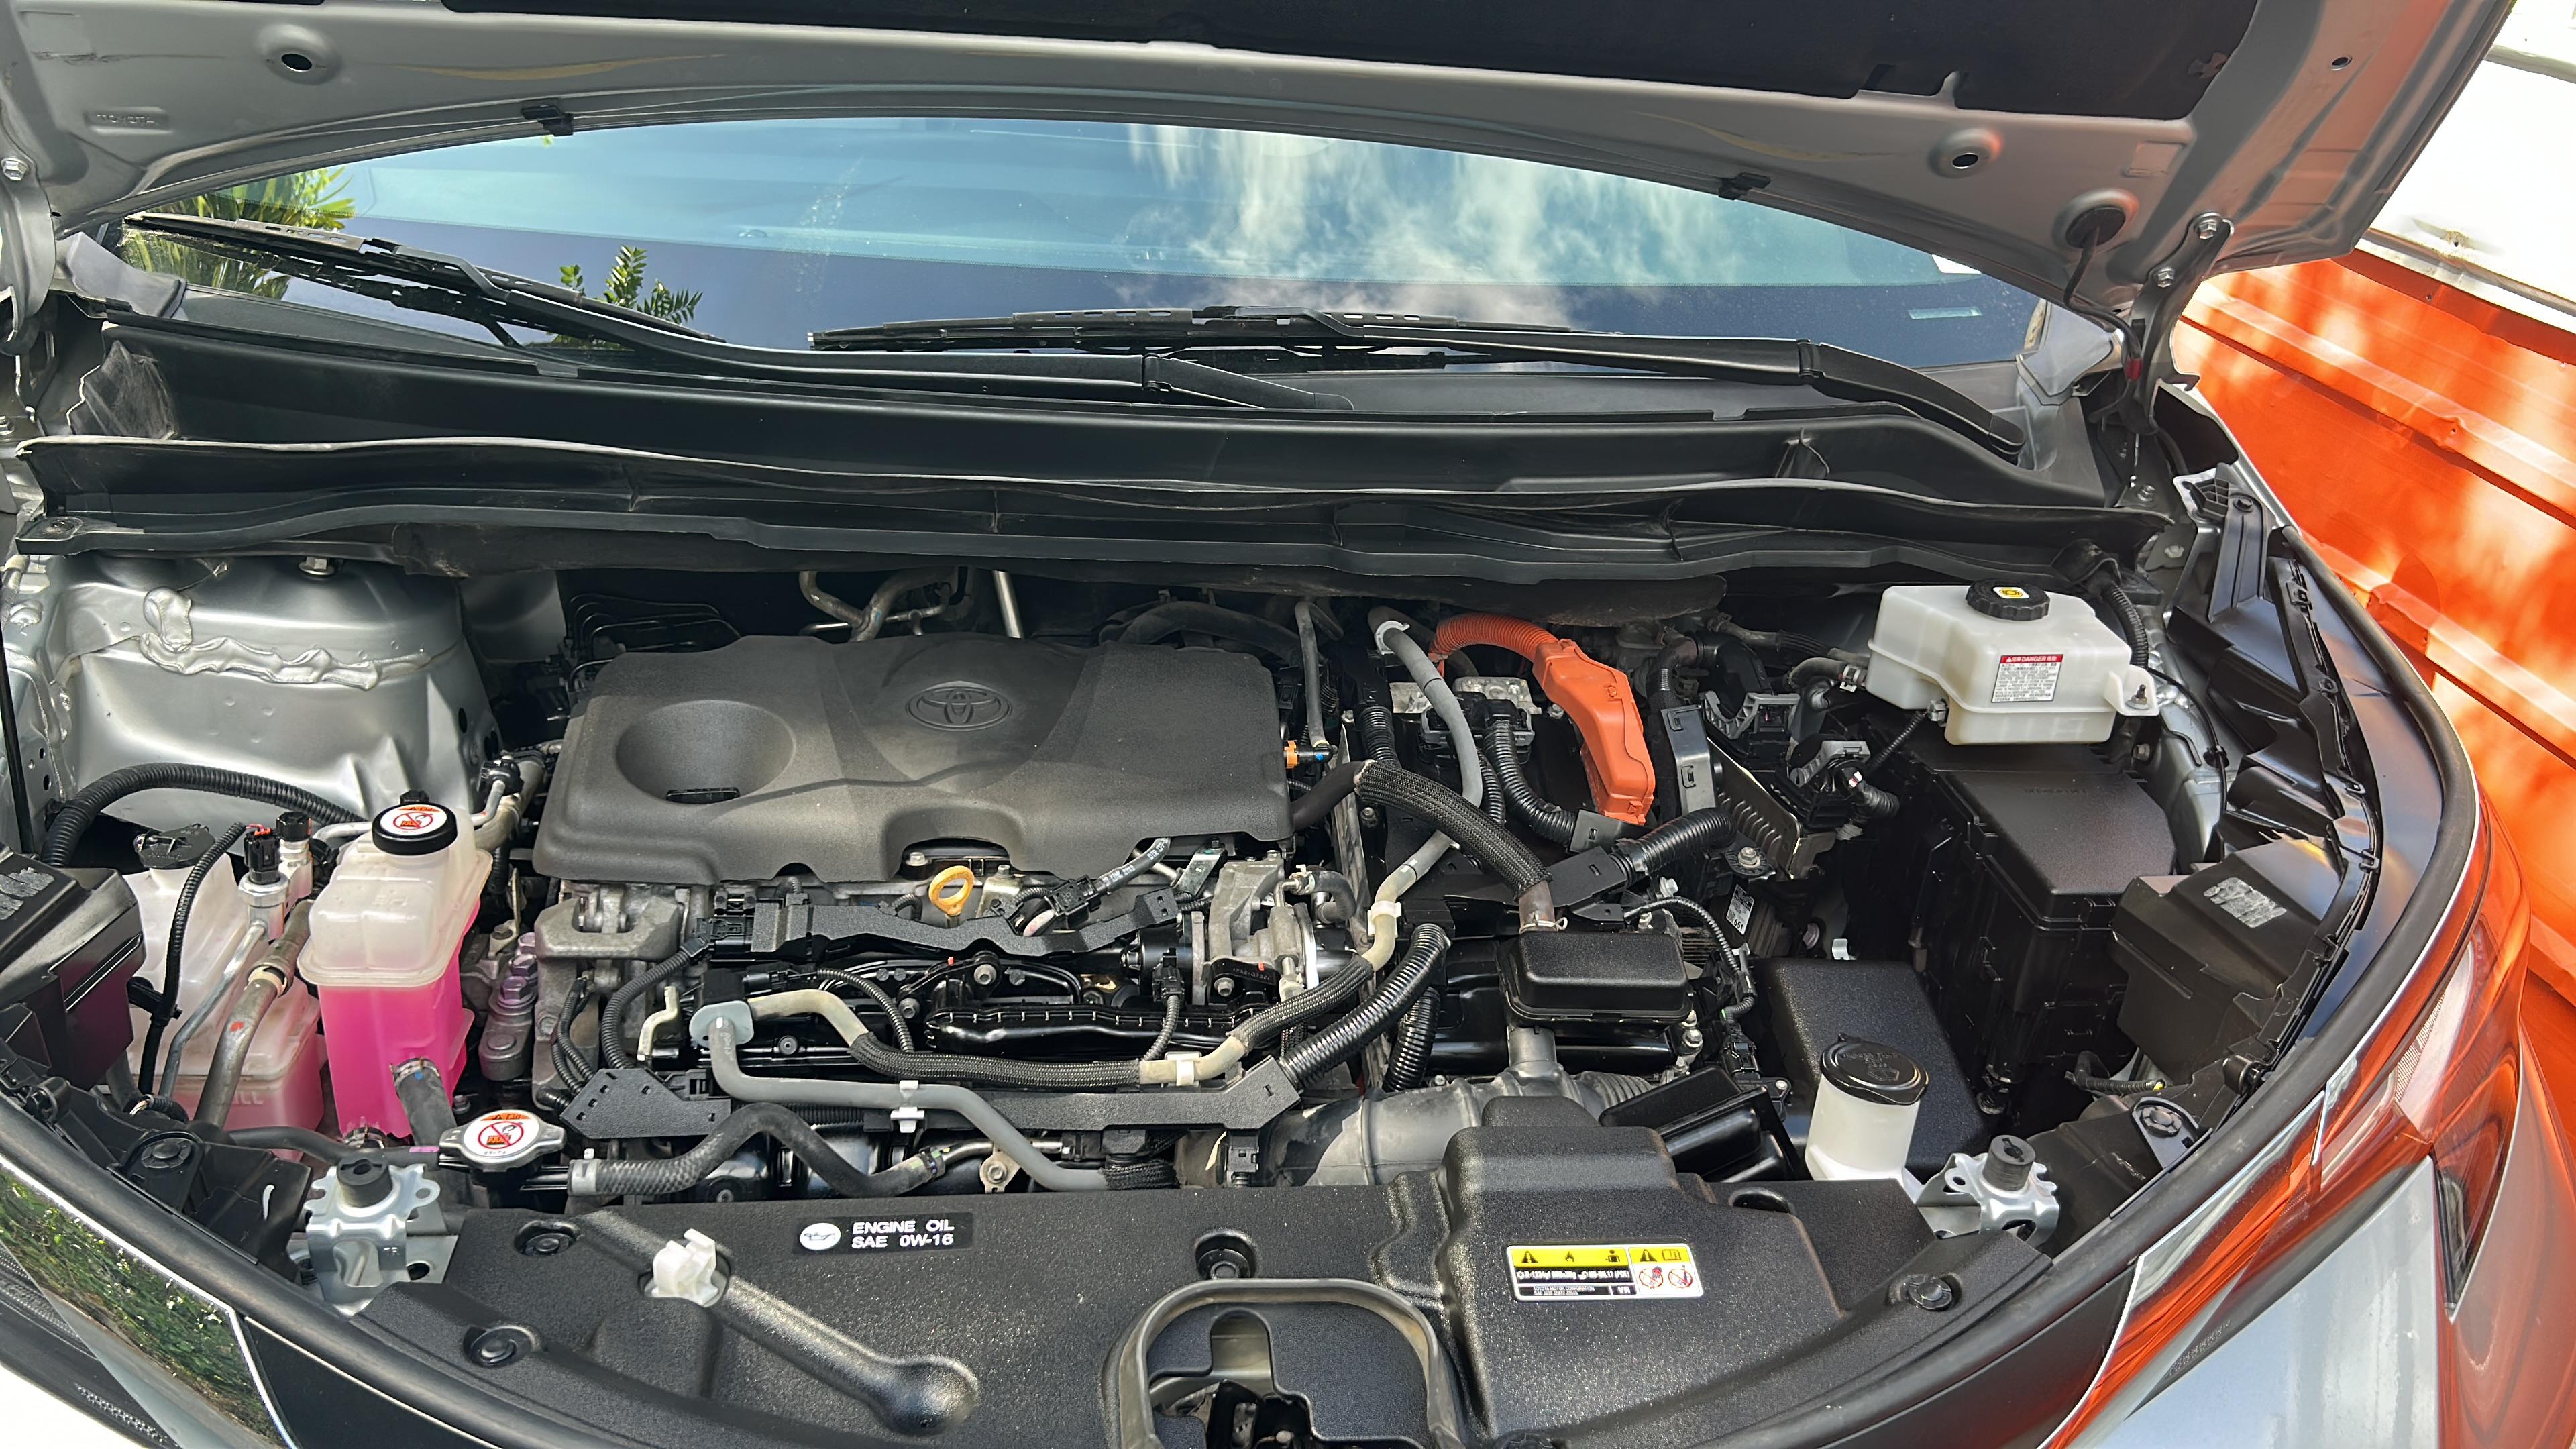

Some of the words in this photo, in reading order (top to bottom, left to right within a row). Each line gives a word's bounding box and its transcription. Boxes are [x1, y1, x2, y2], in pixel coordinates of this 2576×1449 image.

[1733, 918, 1743, 931] 651
[852, 1220, 916, 1234] ENGINE
[926, 1219, 955, 1232] OIL
[851, 1235, 888, 1248] SAE
[899, 1233, 954, 1247] 0W-16
